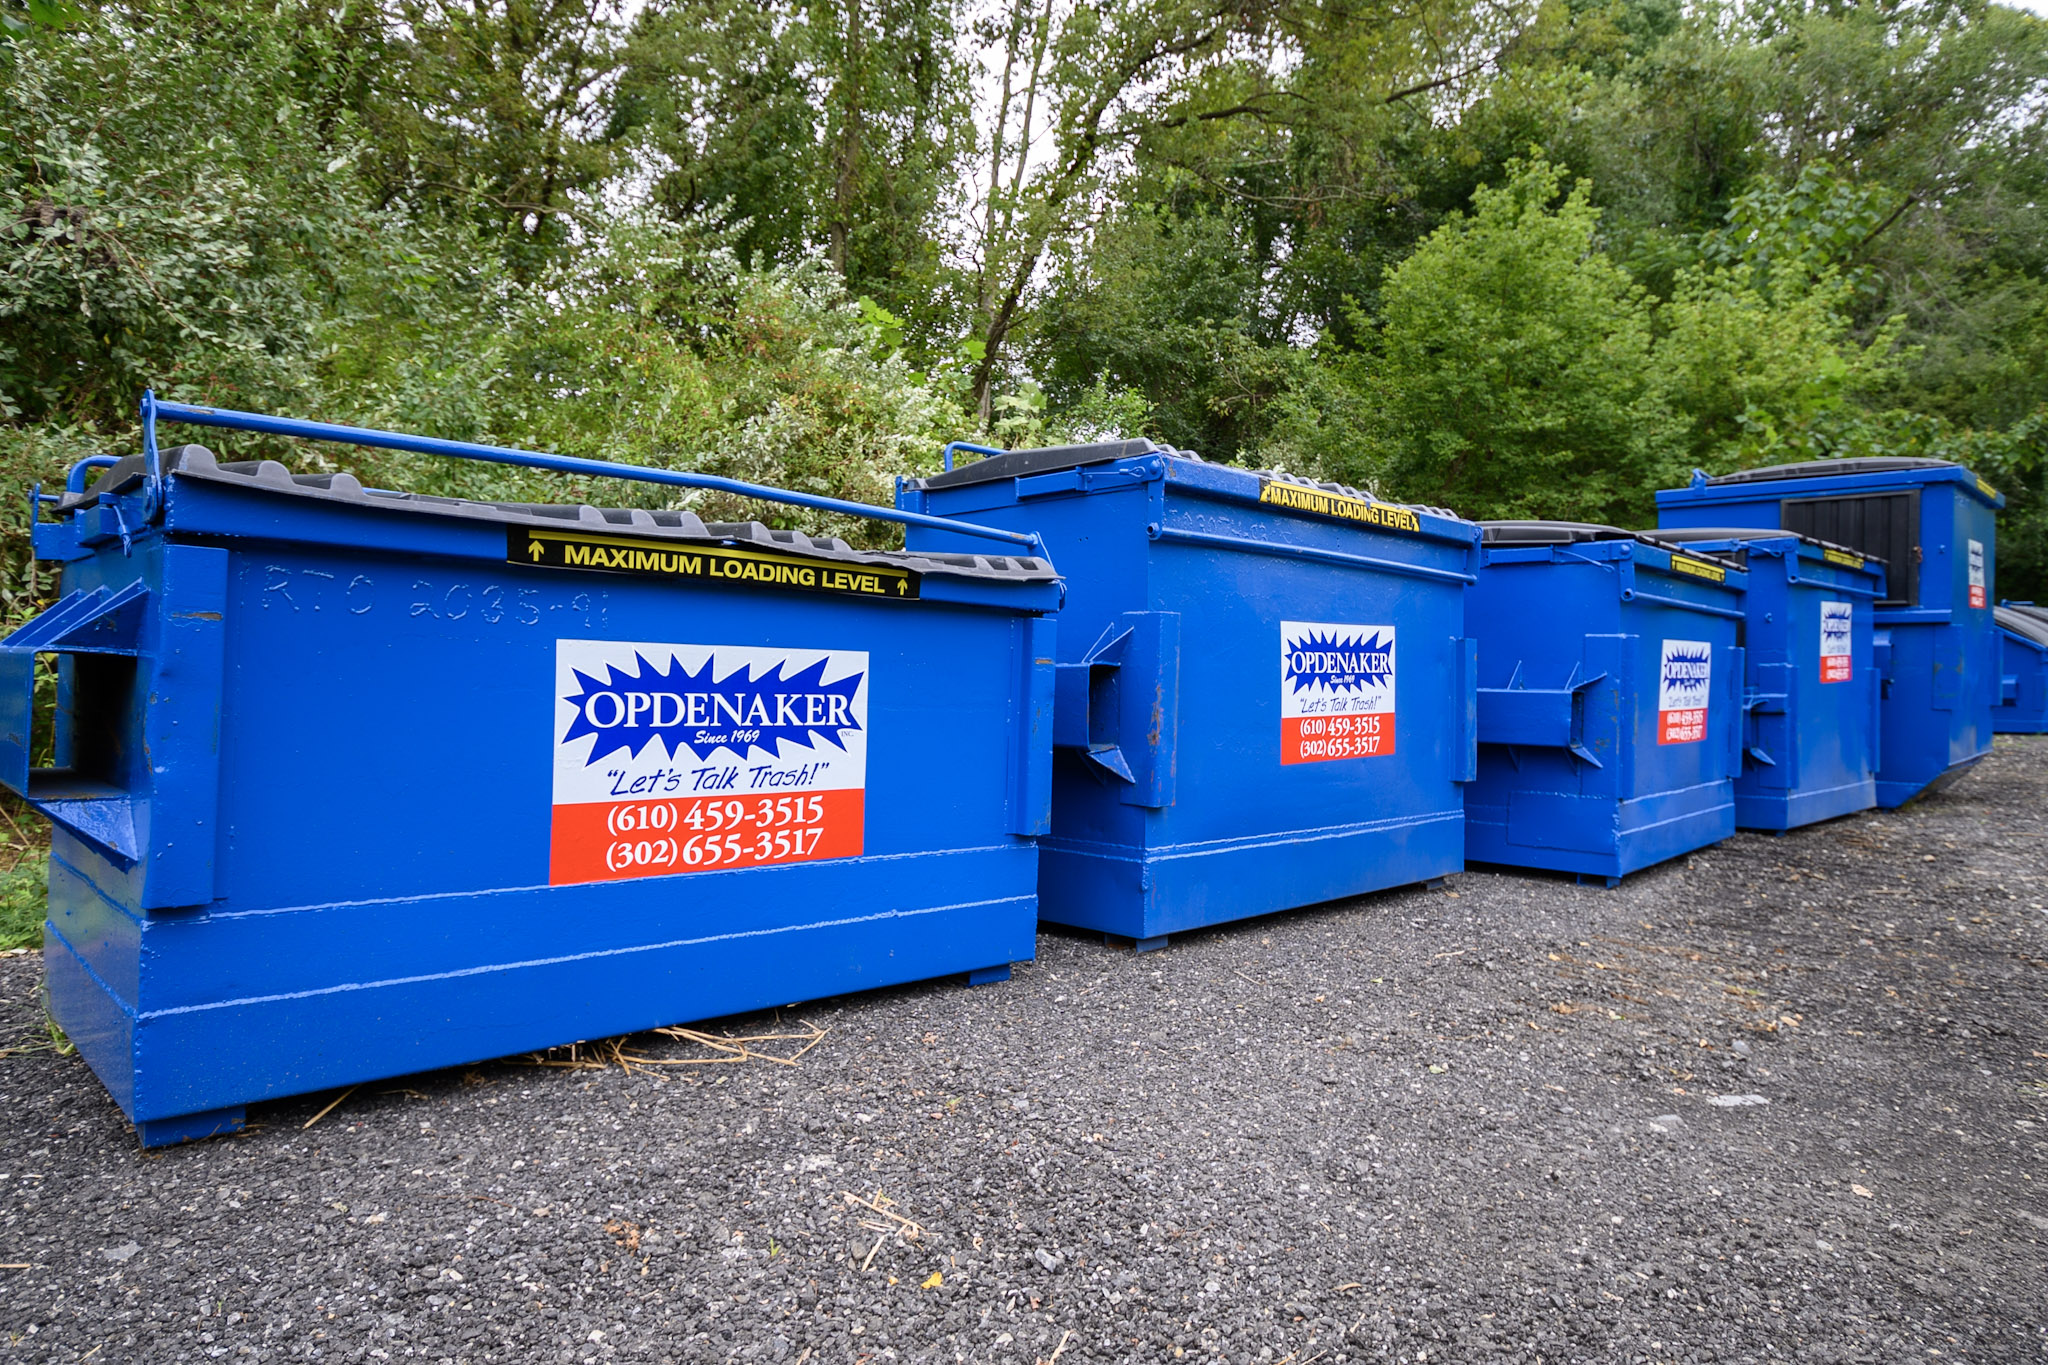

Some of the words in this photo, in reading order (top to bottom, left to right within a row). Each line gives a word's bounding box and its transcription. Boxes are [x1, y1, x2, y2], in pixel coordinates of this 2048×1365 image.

[1270, 486, 1329, 514] MAXIMUM
[1330, 499, 1380, 524] LOADING
[1381, 510, 1413, 531] LEVEL
[563, 544, 702, 575] MAXIMUM
[709, 559, 816, 587] LOADING
[821, 570, 886, 594] LEVEL
[1291, 651, 1390, 674] OPDENAKER
[584, 691, 852, 728] OPDENAKER
[1330, 697, 1348, 712] Talk
[694, 730, 729, 744] Since
[730, 729, 760, 743] 1969
[1300, 718, 1326, 738] (610)
[1327, 716, 1381, 737] 459-3515
[1300, 739, 1327, 759] (302)
[1327, 736, 1381, 757] 655-3517
[691, 763, 740, 791] Talk
[607, 803, 679, 836] (610)
[683, 795, 825, 833] 459-3515
[605, 837, 679, 872] (302)
[682, 827, 825, 866] 655-3517
